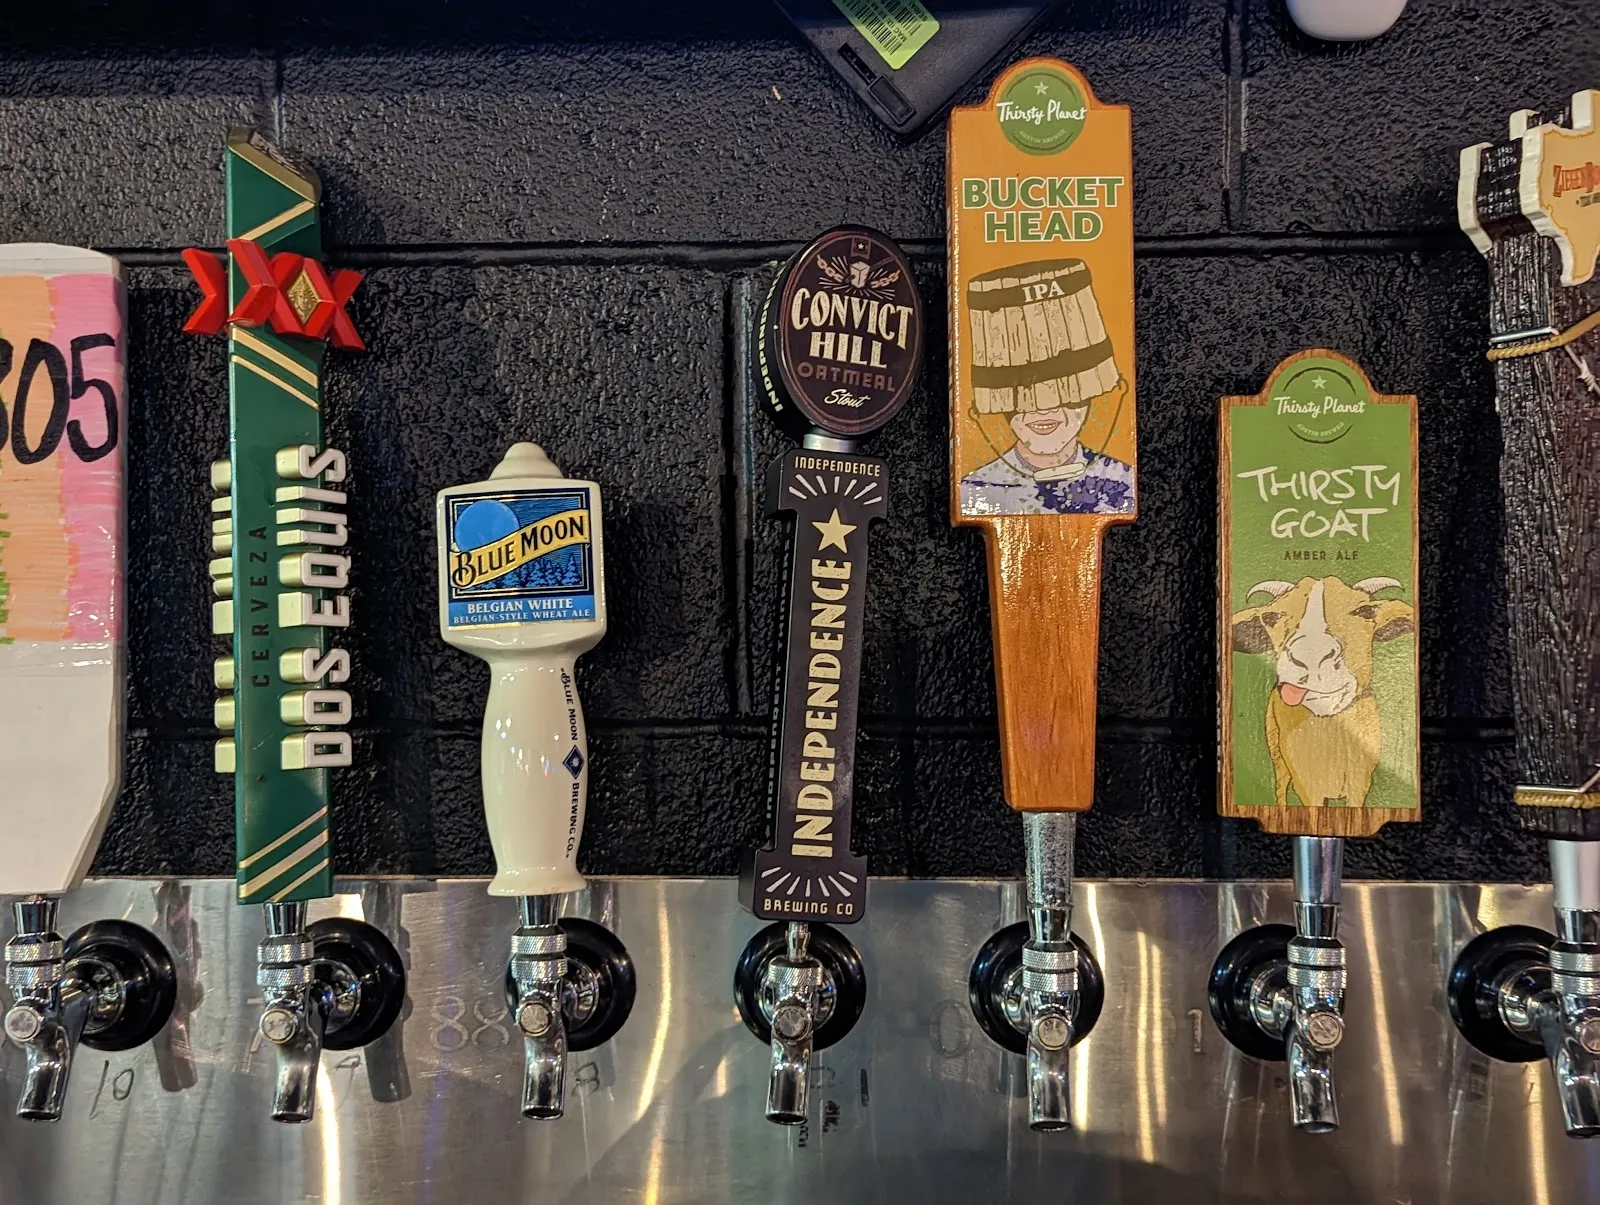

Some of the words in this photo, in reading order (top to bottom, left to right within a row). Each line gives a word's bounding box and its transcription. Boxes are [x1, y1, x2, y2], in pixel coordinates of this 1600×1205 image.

[996, 101, 1044, 126] Thirsty
[1047, 98, 1087, 121] Planet
[962, 176, 1125, 210] BUCKET
[984, 210, 1104, 243] HEAD
[1022, 279, 1065, 303] IPA
[791, 287, 914, 350] CONVICT
[808, 331, 888, 369] HILL
[797, 361, 896, 393] OATMEAL
[824, 388, 871, 408] Stout
[1273, 396, 1321, 419] Thirsty
[1322, 395, 1367, 415] Planet
[794, 455, 881, 478] INDEPENDENCE
[1236, 464, 1400, 506] THIRSTY
[295, 443, 351, 628] EQUIS
[1270, 507, 1389, 543] GOAT
[452, 540, 517, 588] BLUE
[521, 515, 585, 558] MOON
[1284, 550, 1326, 561] AMBER
[1336, 550, 1359, 561] ALE
[249, 525, 270, 687] CERVEZA
[454, 613, 529, 624] BELGIAN-STYLE
[532, 610, 567, 620] WHEAT
[571, 609, 590, 617] ALE
[467, 601, 524, 614] BELGIAN
[528, 598, 574, 611] WHITE
[297, 646, 353, 769] DOS
[560, 673, 574, 705] BLUE
[568, 708, 579, 741] MOON
[791, 558, 852, 858] INDEPENDENCE
[569, 782, 580, 835] BREWING
[763, 898, 829, 915] BREWING
[836, 902, 853, 916] CO
[89, 1059, 136, 1121] 10
